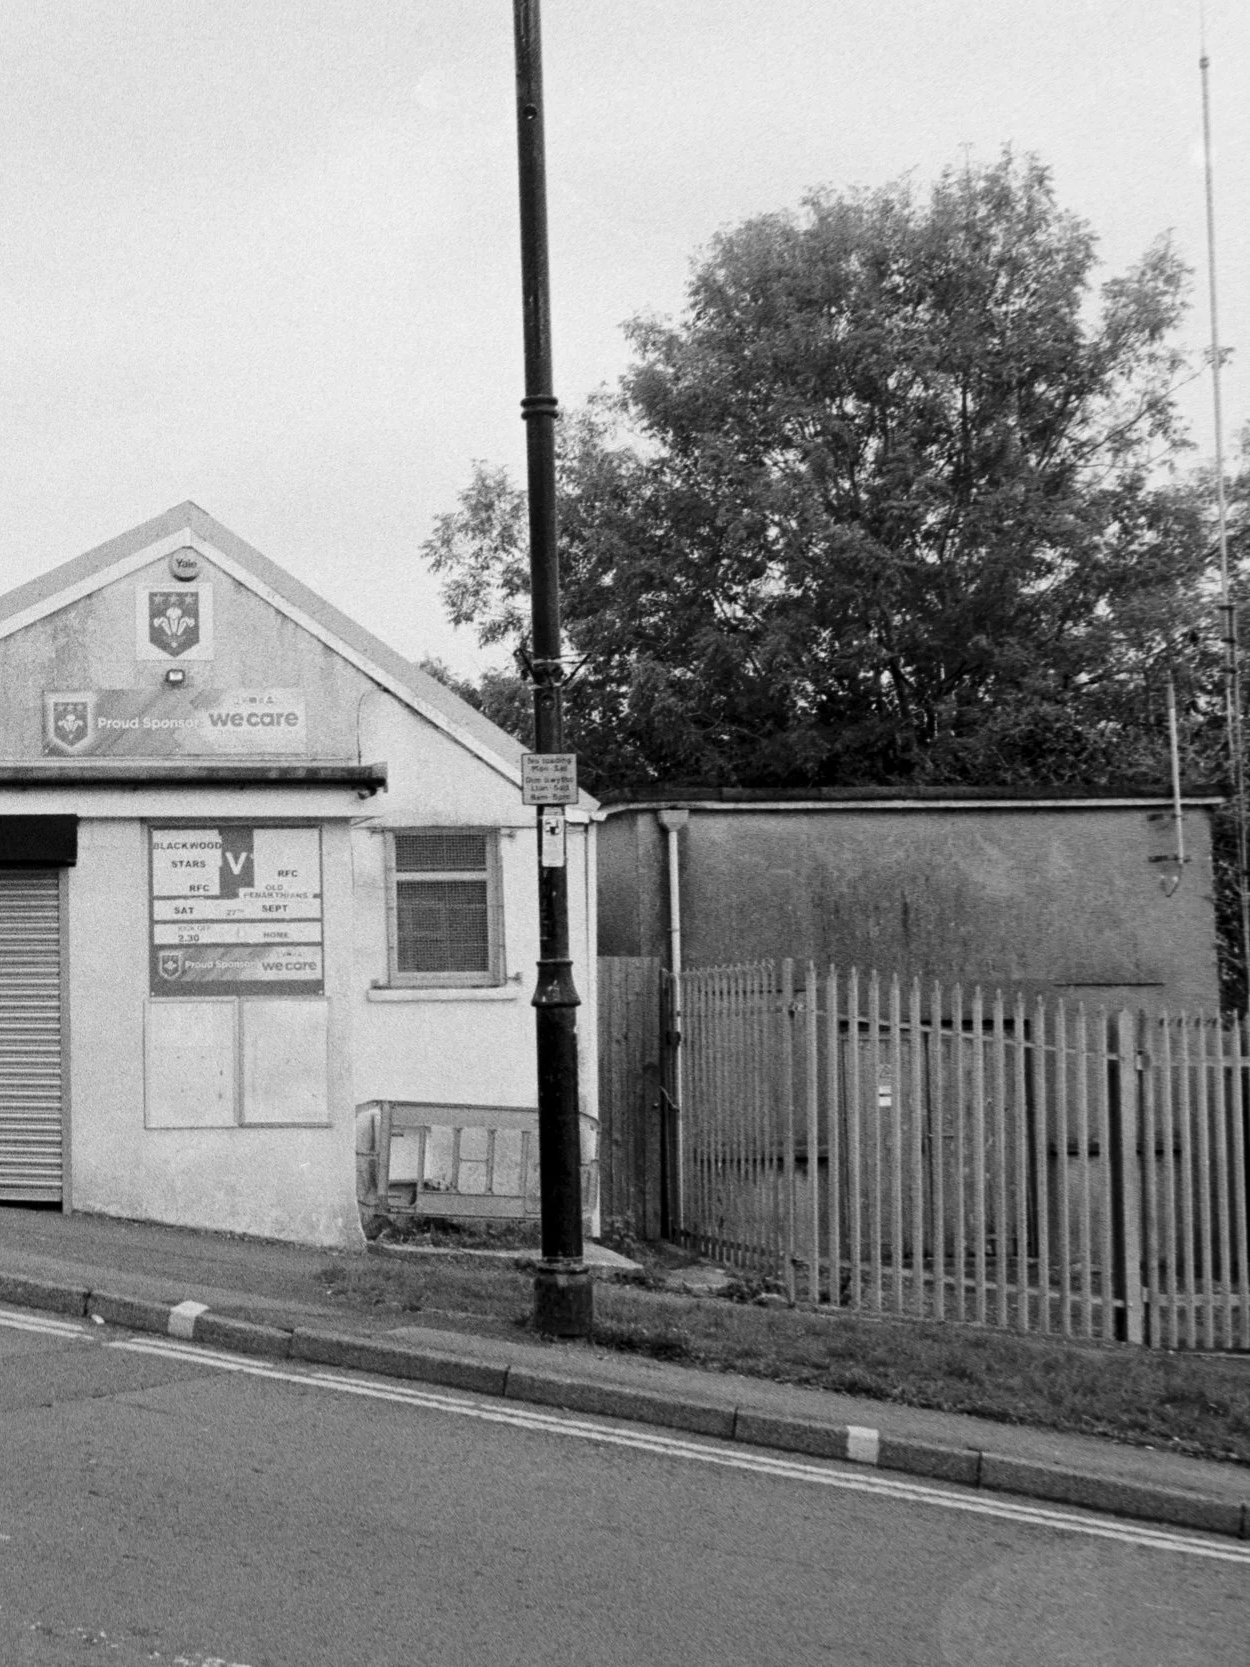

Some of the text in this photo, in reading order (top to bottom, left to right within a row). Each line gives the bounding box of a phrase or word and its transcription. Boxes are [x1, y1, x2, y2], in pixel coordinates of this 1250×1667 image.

[175, 558, 198, 569] Yale
[97, 716, 139, 729] Proud
[153, 841, 222, 850] BLACKWOOD
[171, 860, 207, 868] STARS
[225, 851, 248, 876] V
[277, 869, 298, 877] RFC
[189, 884, 210, 892] RFC
[174, 906, 195, 915] SAT
[261, 904, 289, 913] SEPT
